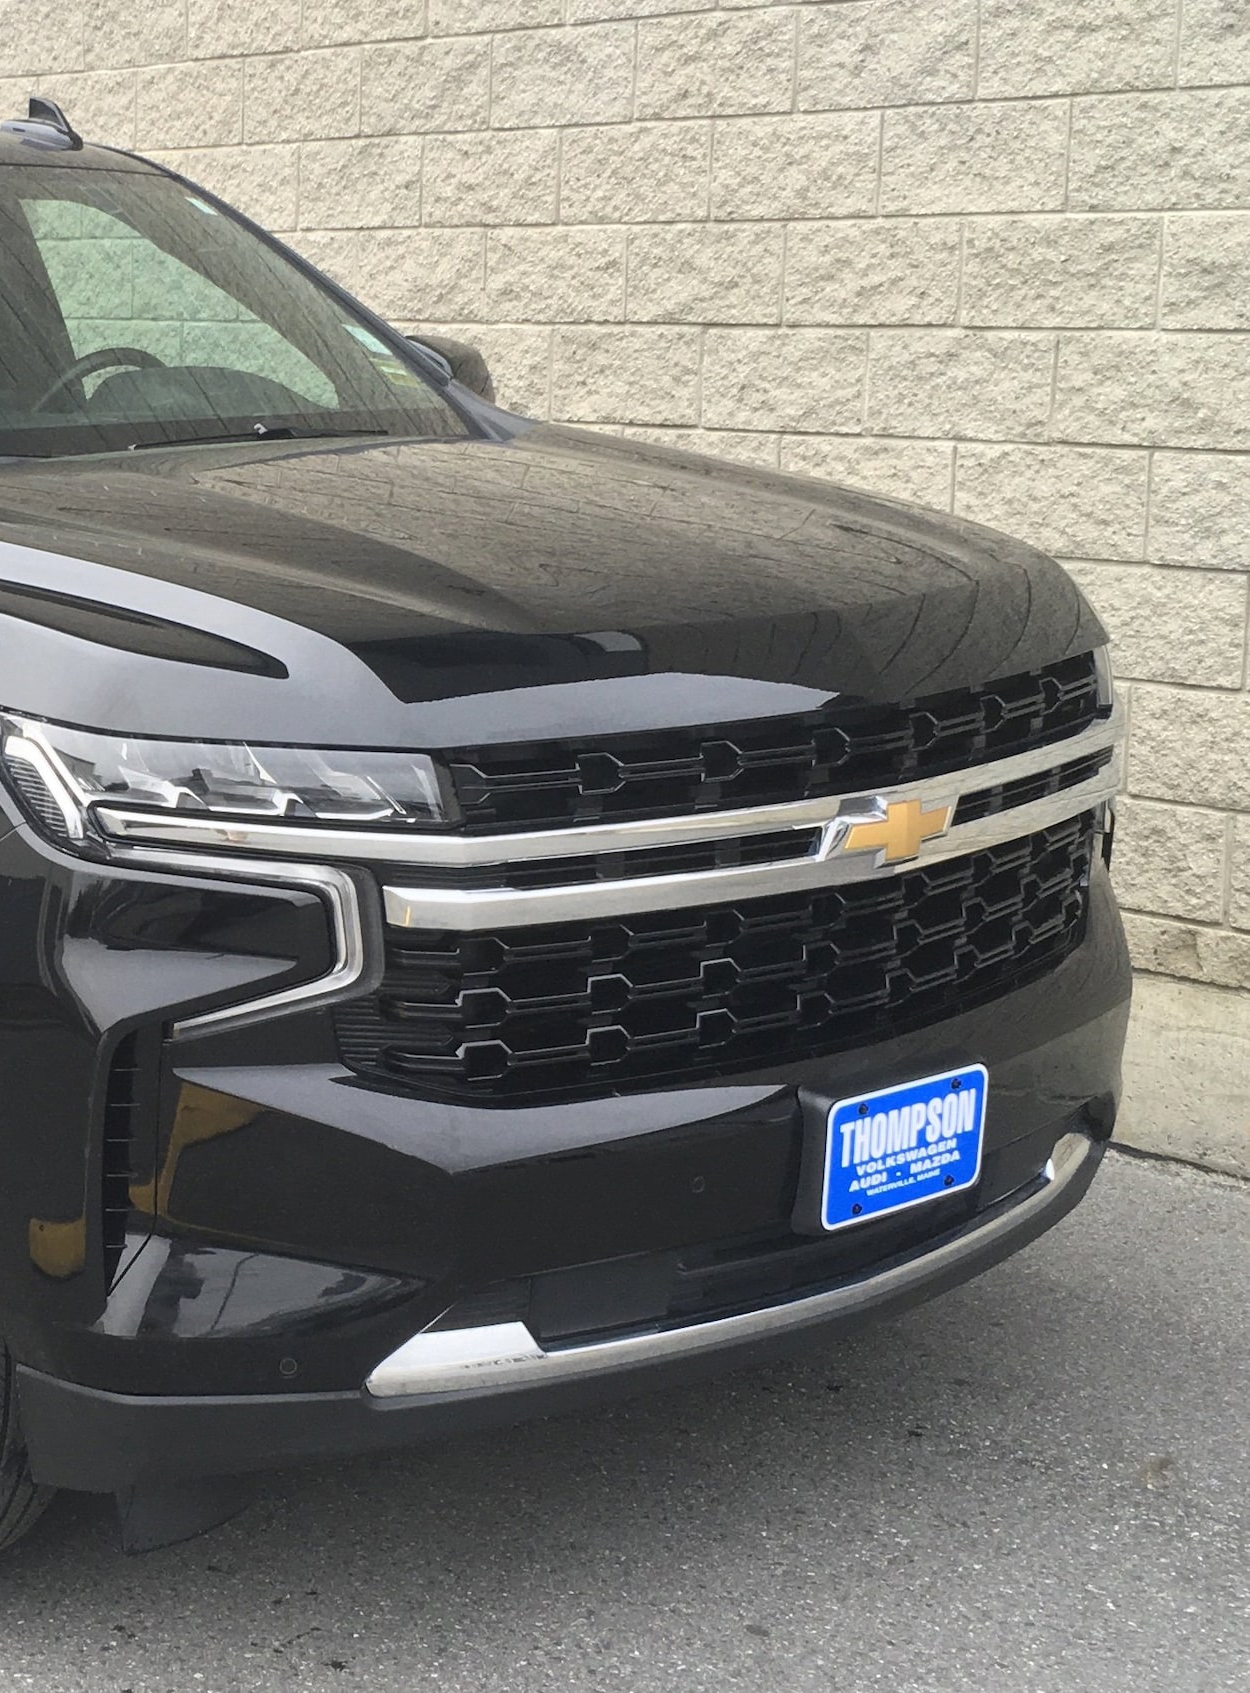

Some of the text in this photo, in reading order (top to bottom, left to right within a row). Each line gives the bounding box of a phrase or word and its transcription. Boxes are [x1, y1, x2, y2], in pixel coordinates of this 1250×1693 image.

[839, 1087, 977, 1168] THOMPSON
[848, 1150, 961, 1193] AUDI MAZDA
[856, 1138, 958, 1176] VOLKSWAGEN
[916, 1168, 941, 1181] MAINE
